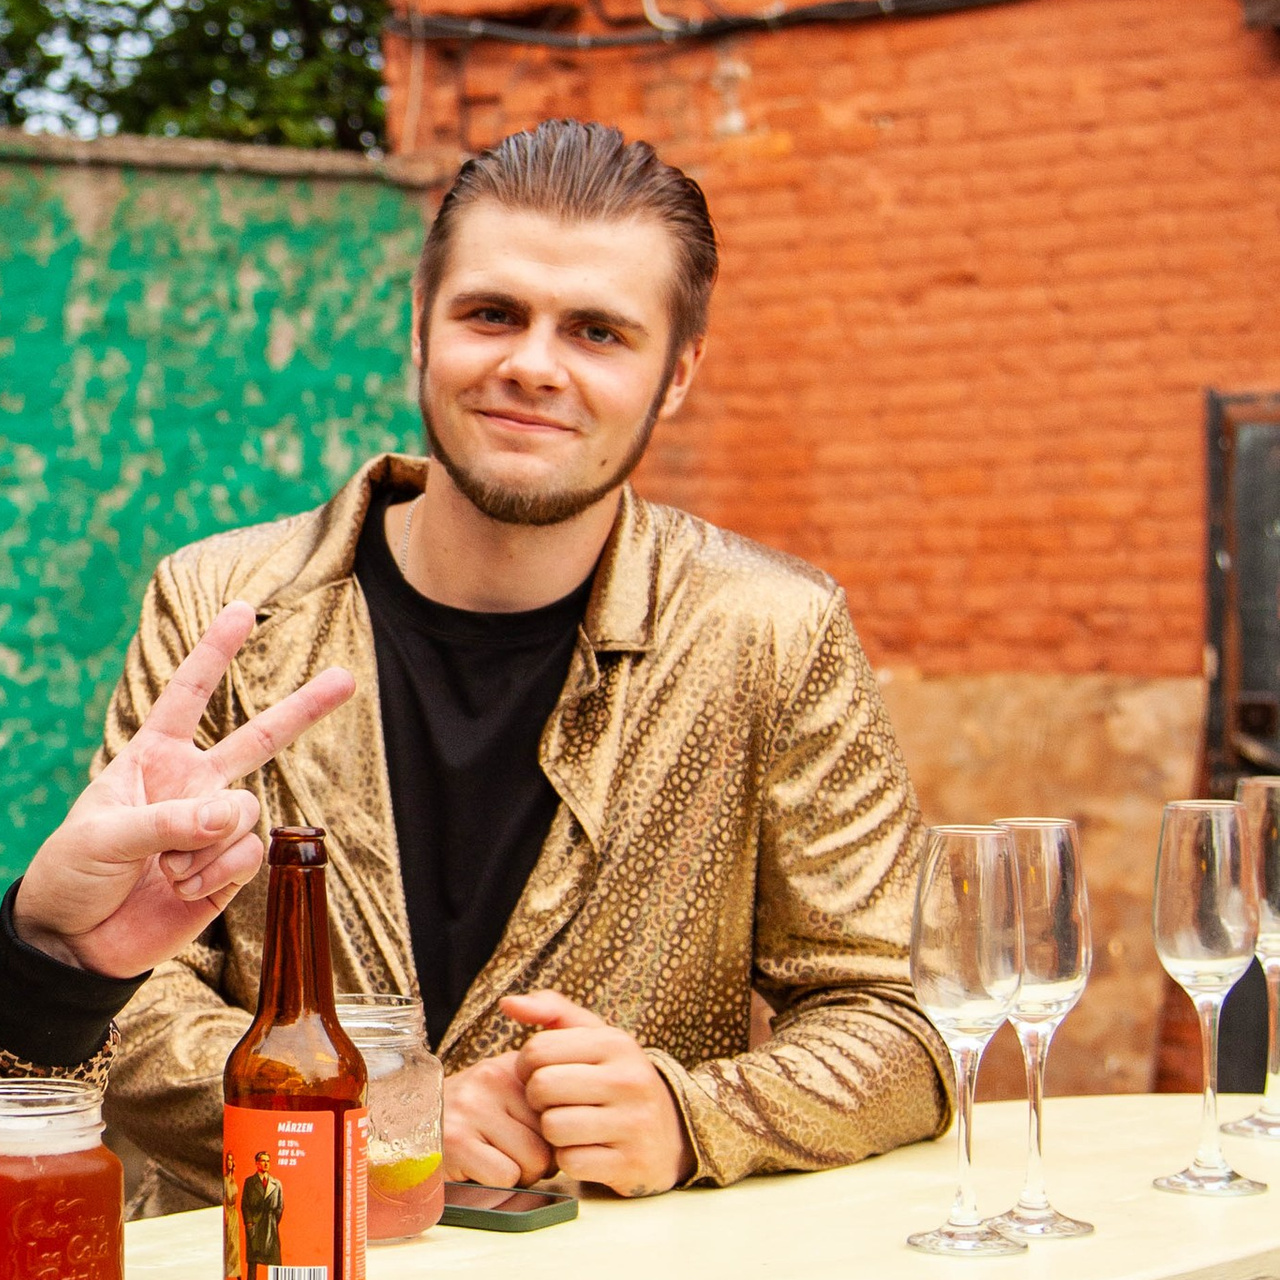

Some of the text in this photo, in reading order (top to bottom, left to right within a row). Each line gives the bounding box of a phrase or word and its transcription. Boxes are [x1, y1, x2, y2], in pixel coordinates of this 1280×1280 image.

[277, 1121, 314, 1133] MÄRZEN
[277, 1149, 290, 1157] ABV
[277, 1158, 289, 1166] IBU
